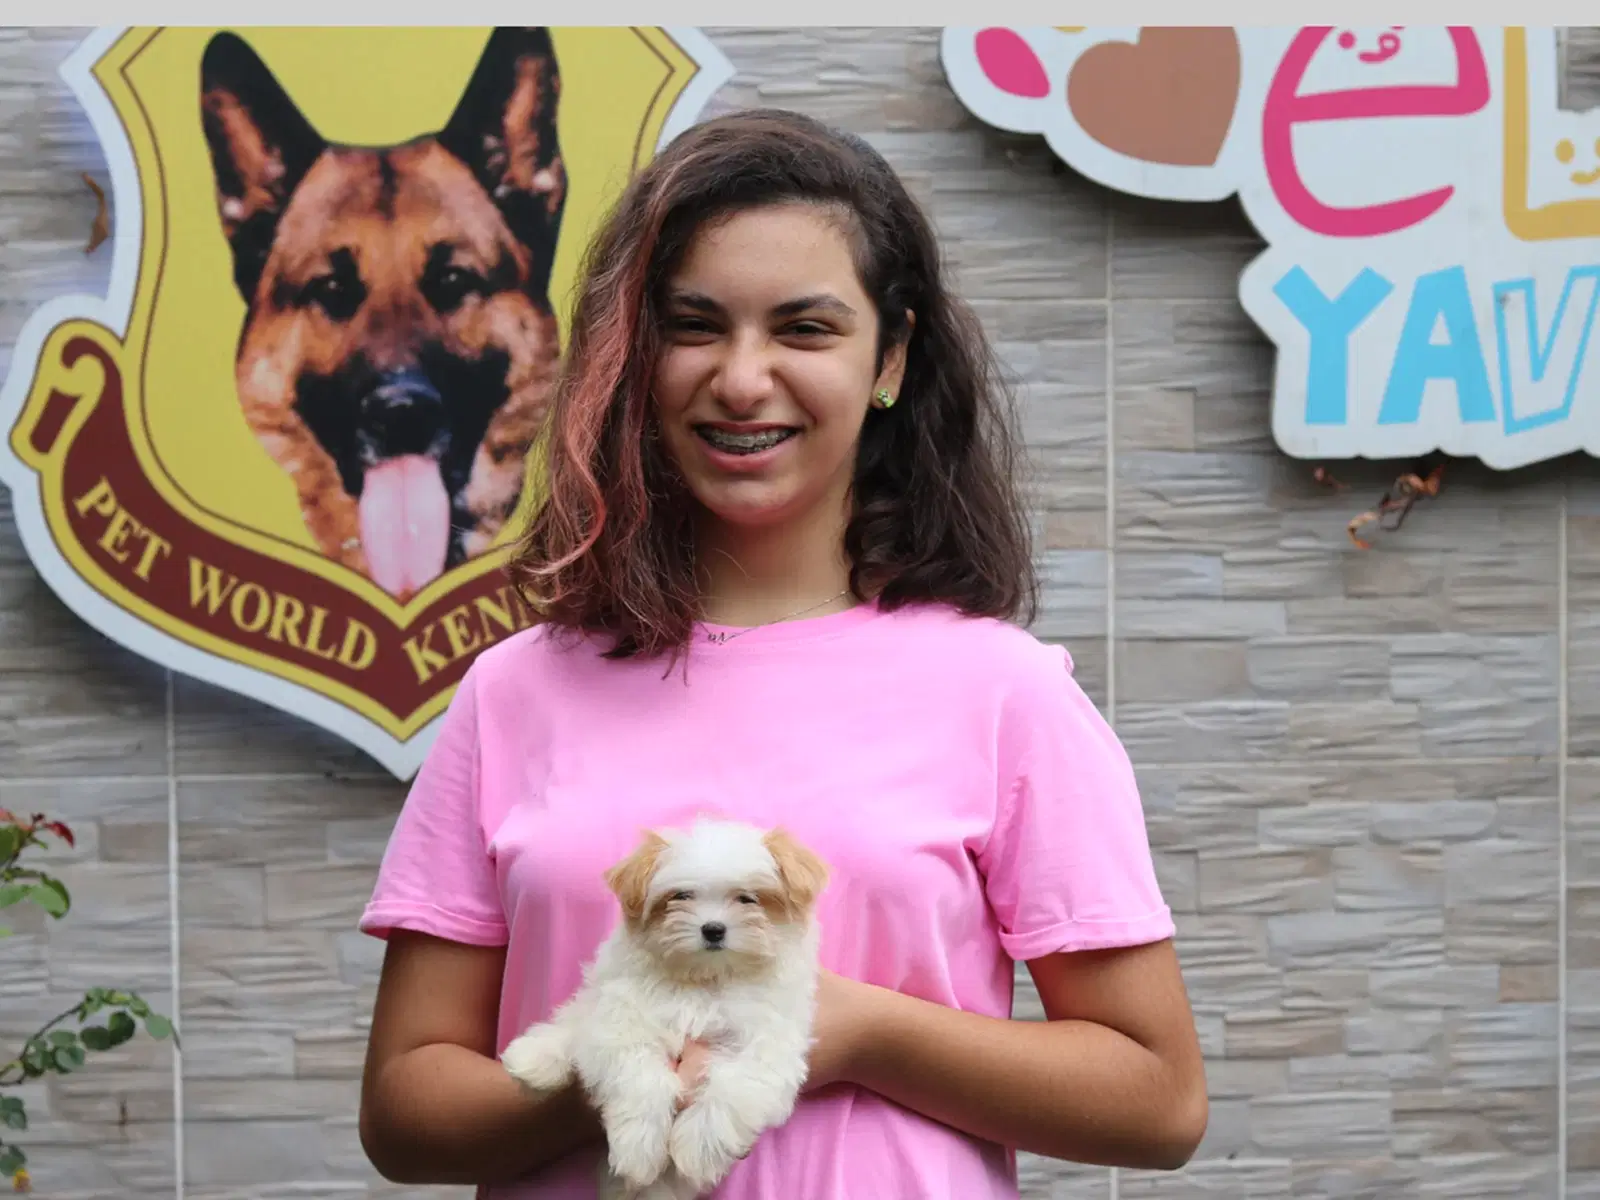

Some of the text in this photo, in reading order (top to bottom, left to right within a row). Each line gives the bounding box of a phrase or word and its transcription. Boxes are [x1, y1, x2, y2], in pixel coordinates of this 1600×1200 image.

[1272, 264, 1600, 437] YAV
[73, 476, 171, 582] PET
[187, 555, 378, 671] WORLD
